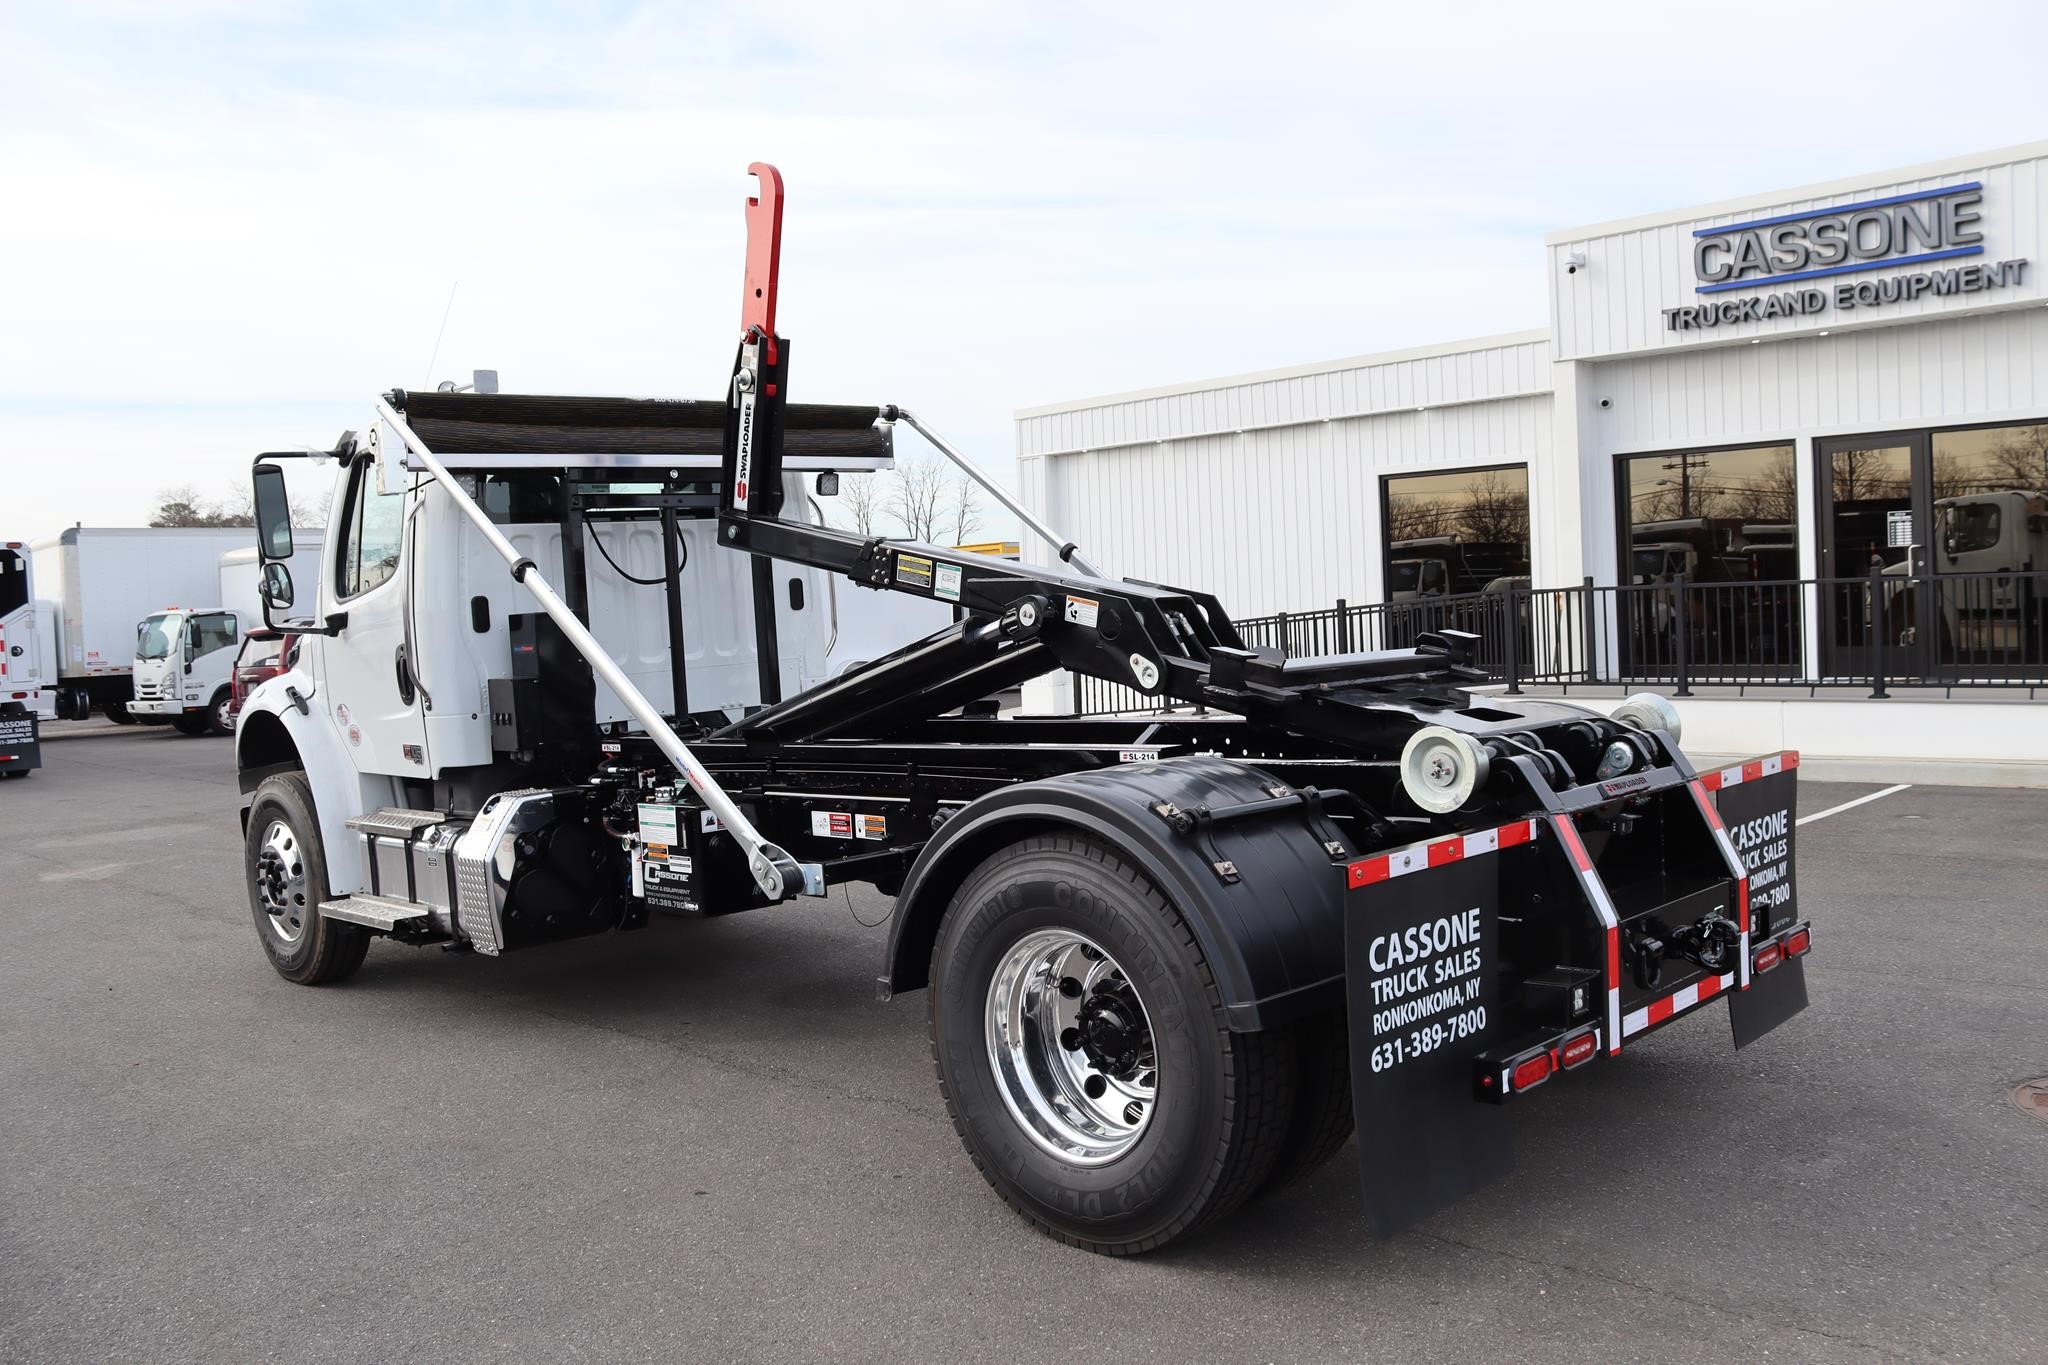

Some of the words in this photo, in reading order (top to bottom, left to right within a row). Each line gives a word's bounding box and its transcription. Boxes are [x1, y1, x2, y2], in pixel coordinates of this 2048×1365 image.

[1694, 192, 1984, 282] CASSONE
[1834, 259, 2028, 309] EQUIPMENT
[740, 403, 752, 479] SWAPLOADER
[0, 720, 32, 728] ASSONE
[1129, 753, 1155, 761] SL-214
[644, 862, 689, 884] CASSONE
[1742, 850, 1760, 870] UCK
[1763, 839, 1787, 864] SALES
[1778, 861, 1787, 877] NY
[1369, 908, 1481, 973] CASSONE
[1371, 964, 1429, 1005] TRUCK
[1435, 947, 1481, 984] SALES
[1373, 986, 1465, 1036] RONKONKOMA,
[1466, 977, 1481, 1001] NY
[1371, 1006, 1487, 1073] 631-389-7800
